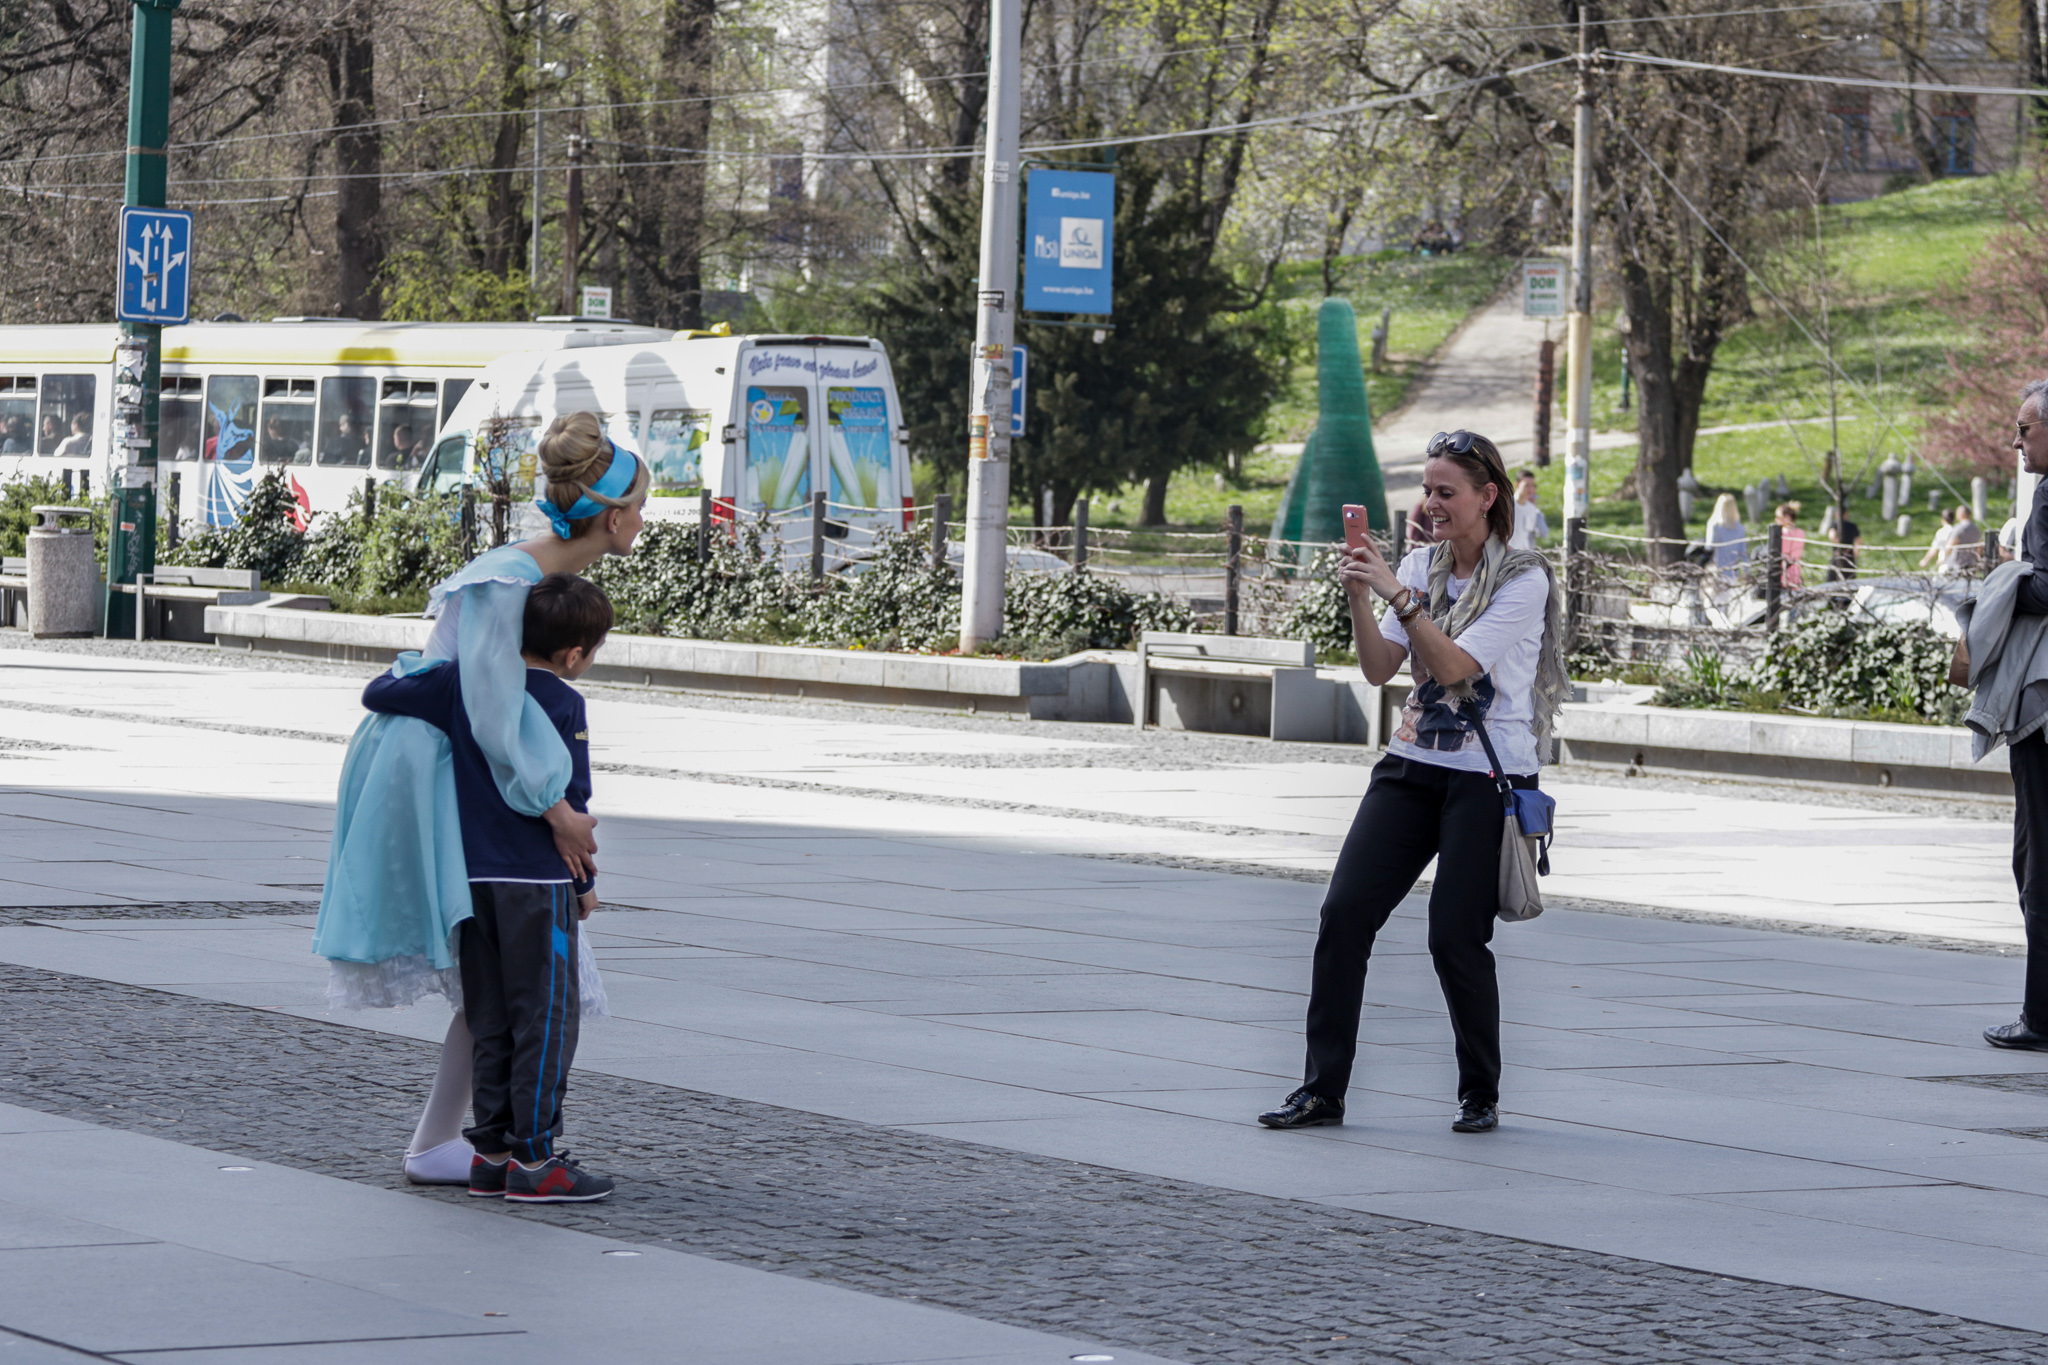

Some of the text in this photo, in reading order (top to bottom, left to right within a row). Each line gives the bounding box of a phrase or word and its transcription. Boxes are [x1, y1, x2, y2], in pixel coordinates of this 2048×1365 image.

[1063, 248, 1099, 260] UNIQA
[1530, 277, 1557, 289] DOM
[587, 297, 606, 307] DOM
[829, 391, 885, 403] PRODUCT
